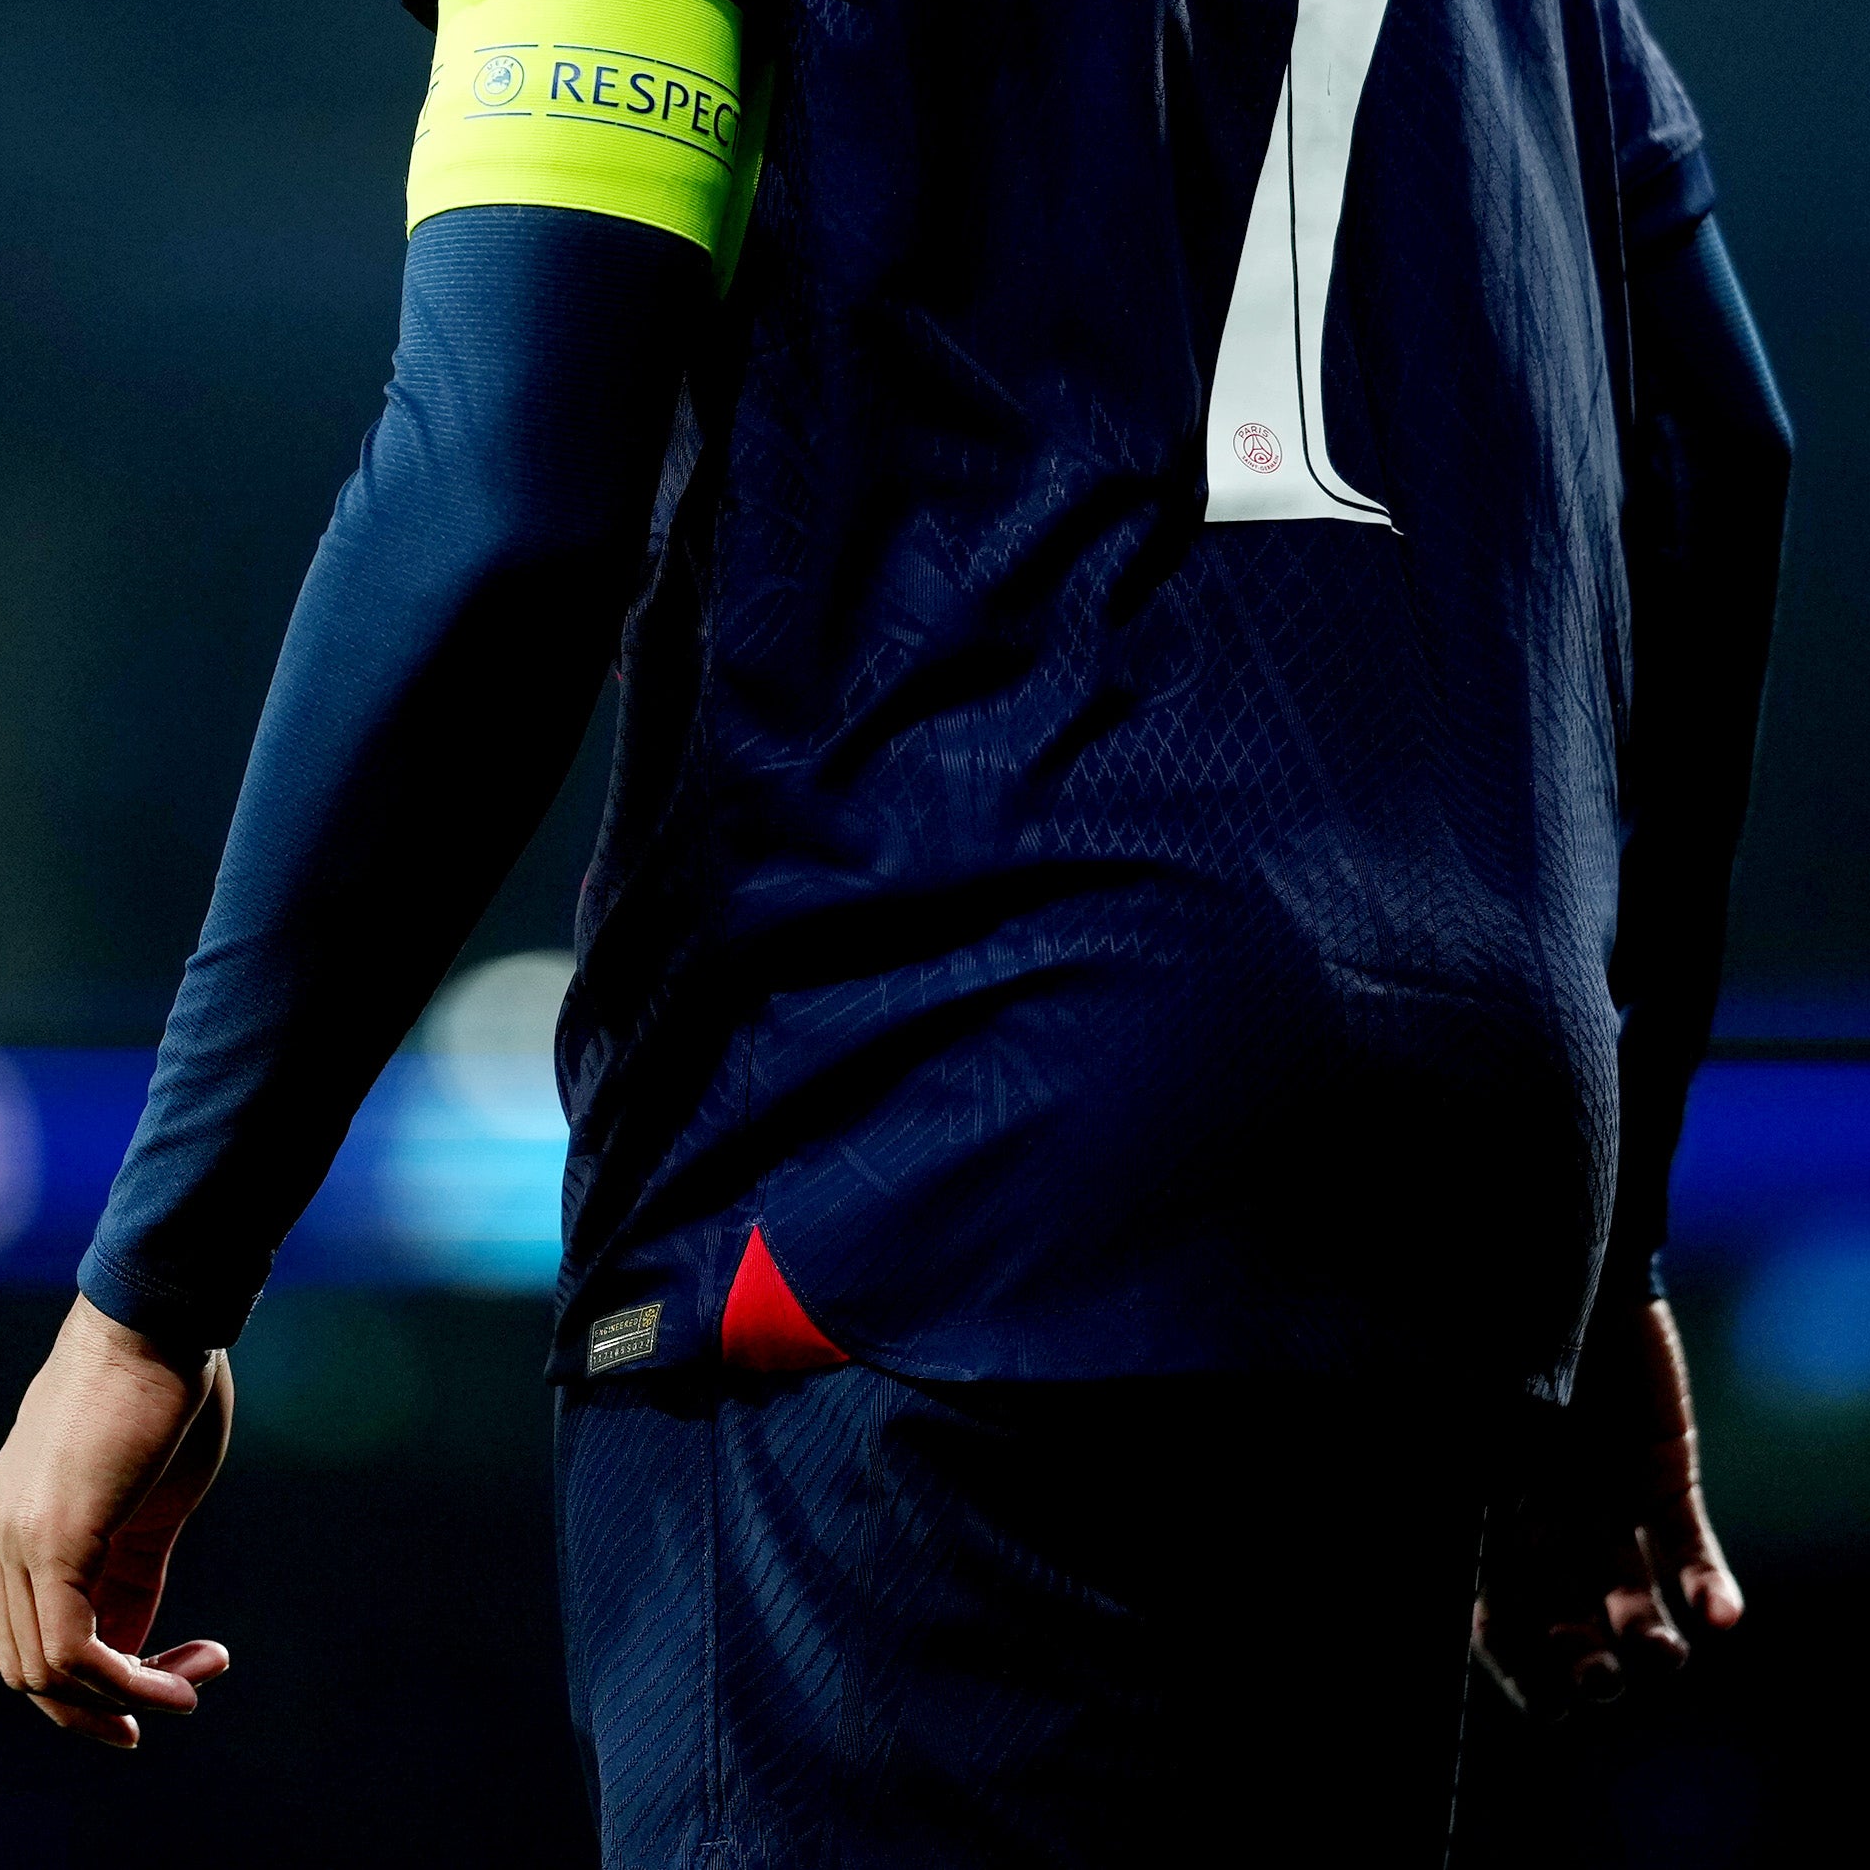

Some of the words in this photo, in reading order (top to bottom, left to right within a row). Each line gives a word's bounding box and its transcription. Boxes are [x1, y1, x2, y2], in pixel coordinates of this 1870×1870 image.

[486, 59, 515, 71] UEFA
[1238, 425, 1270, 439] PARIS
[594, 1317, 639, 1338] ENGINEERED
